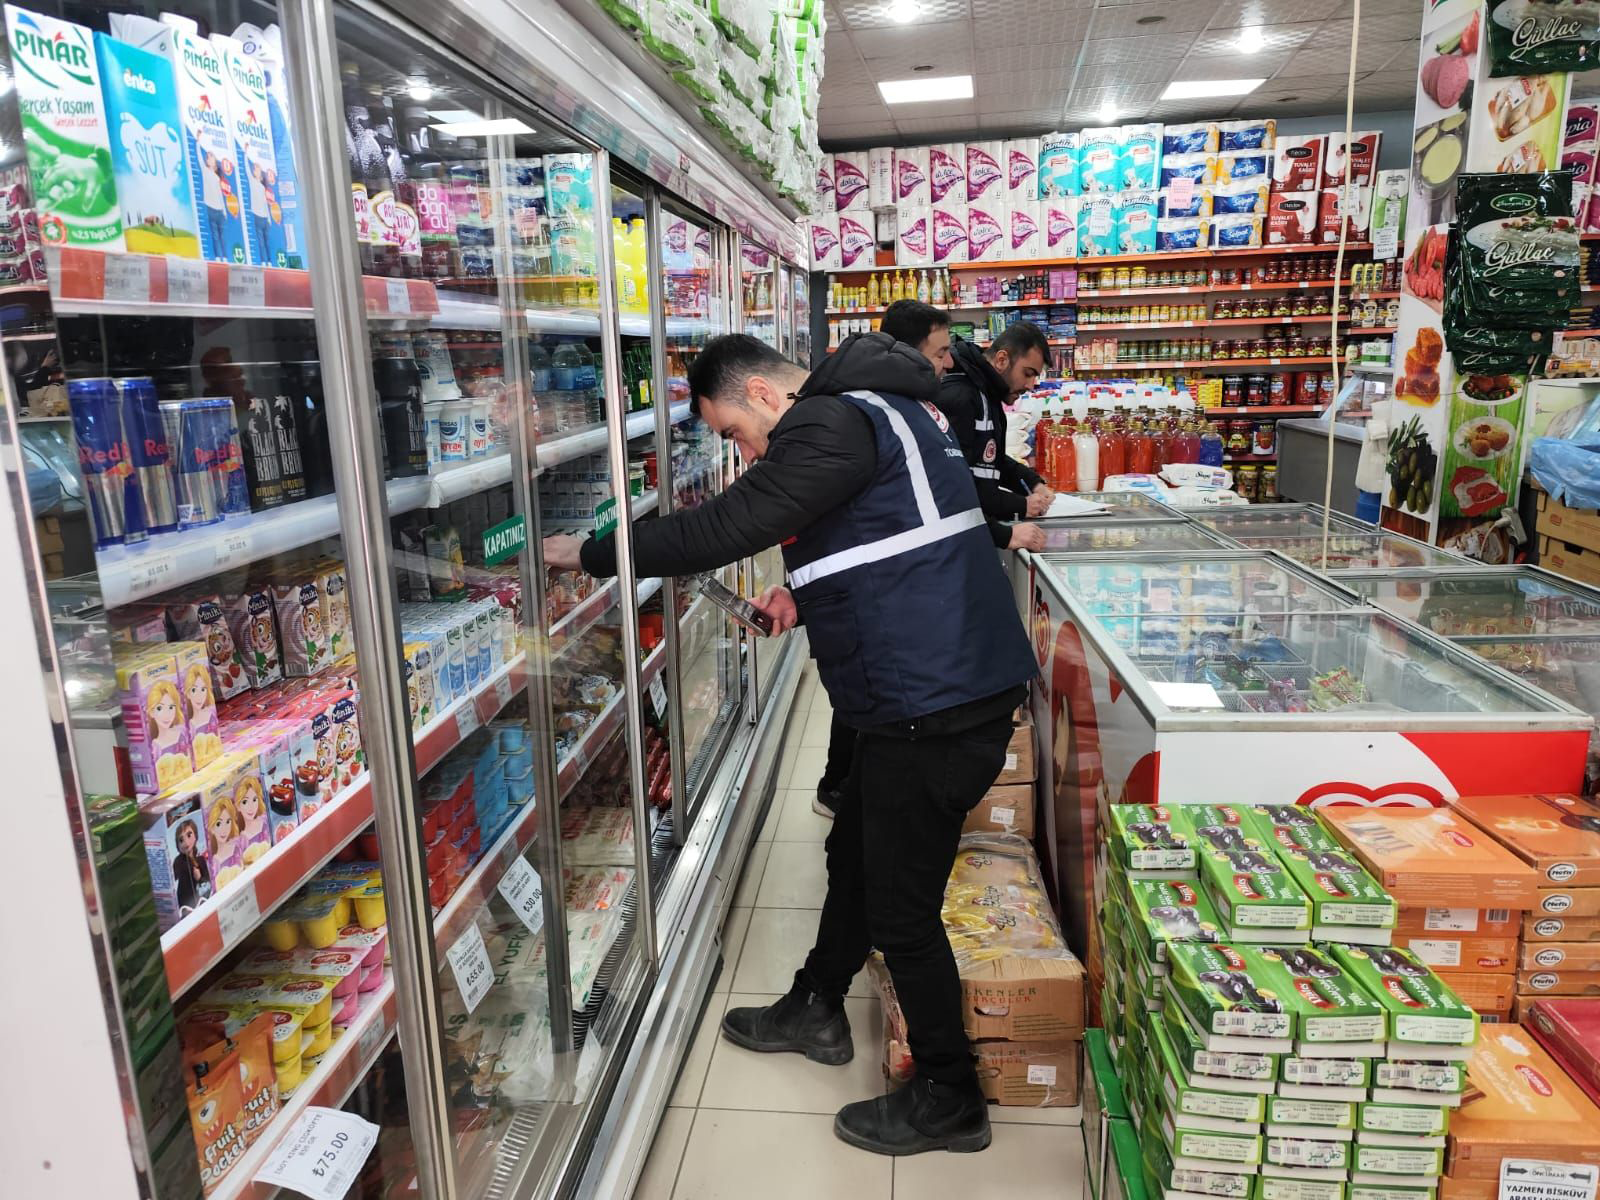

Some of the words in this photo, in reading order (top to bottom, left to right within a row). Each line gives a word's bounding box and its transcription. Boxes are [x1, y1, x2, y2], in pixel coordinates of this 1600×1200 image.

[15, 29, 89, 68] PINAR
[183, 49, 219, 74] PINAR
[233, 67, 263, 90] PINAR
[54, 97, 95, 117] Yaşam
[188, 105, 224, 127] çocuk
[237, 120, 268, 140] çocuk
[135, 135, 167, 178] SÜT
[484, 522, 525, 557] KAPATINIZ
[205, 1123, 236, 1165] Fruit
[312, 1131, 350, 1178] ₺75.00
[200, 1135, 246, 1187] Pocket
[1506, 1185, 1544, 1195] YAZMEN
[1546, 1186, 1588, 1199] BİSKÜVİ
